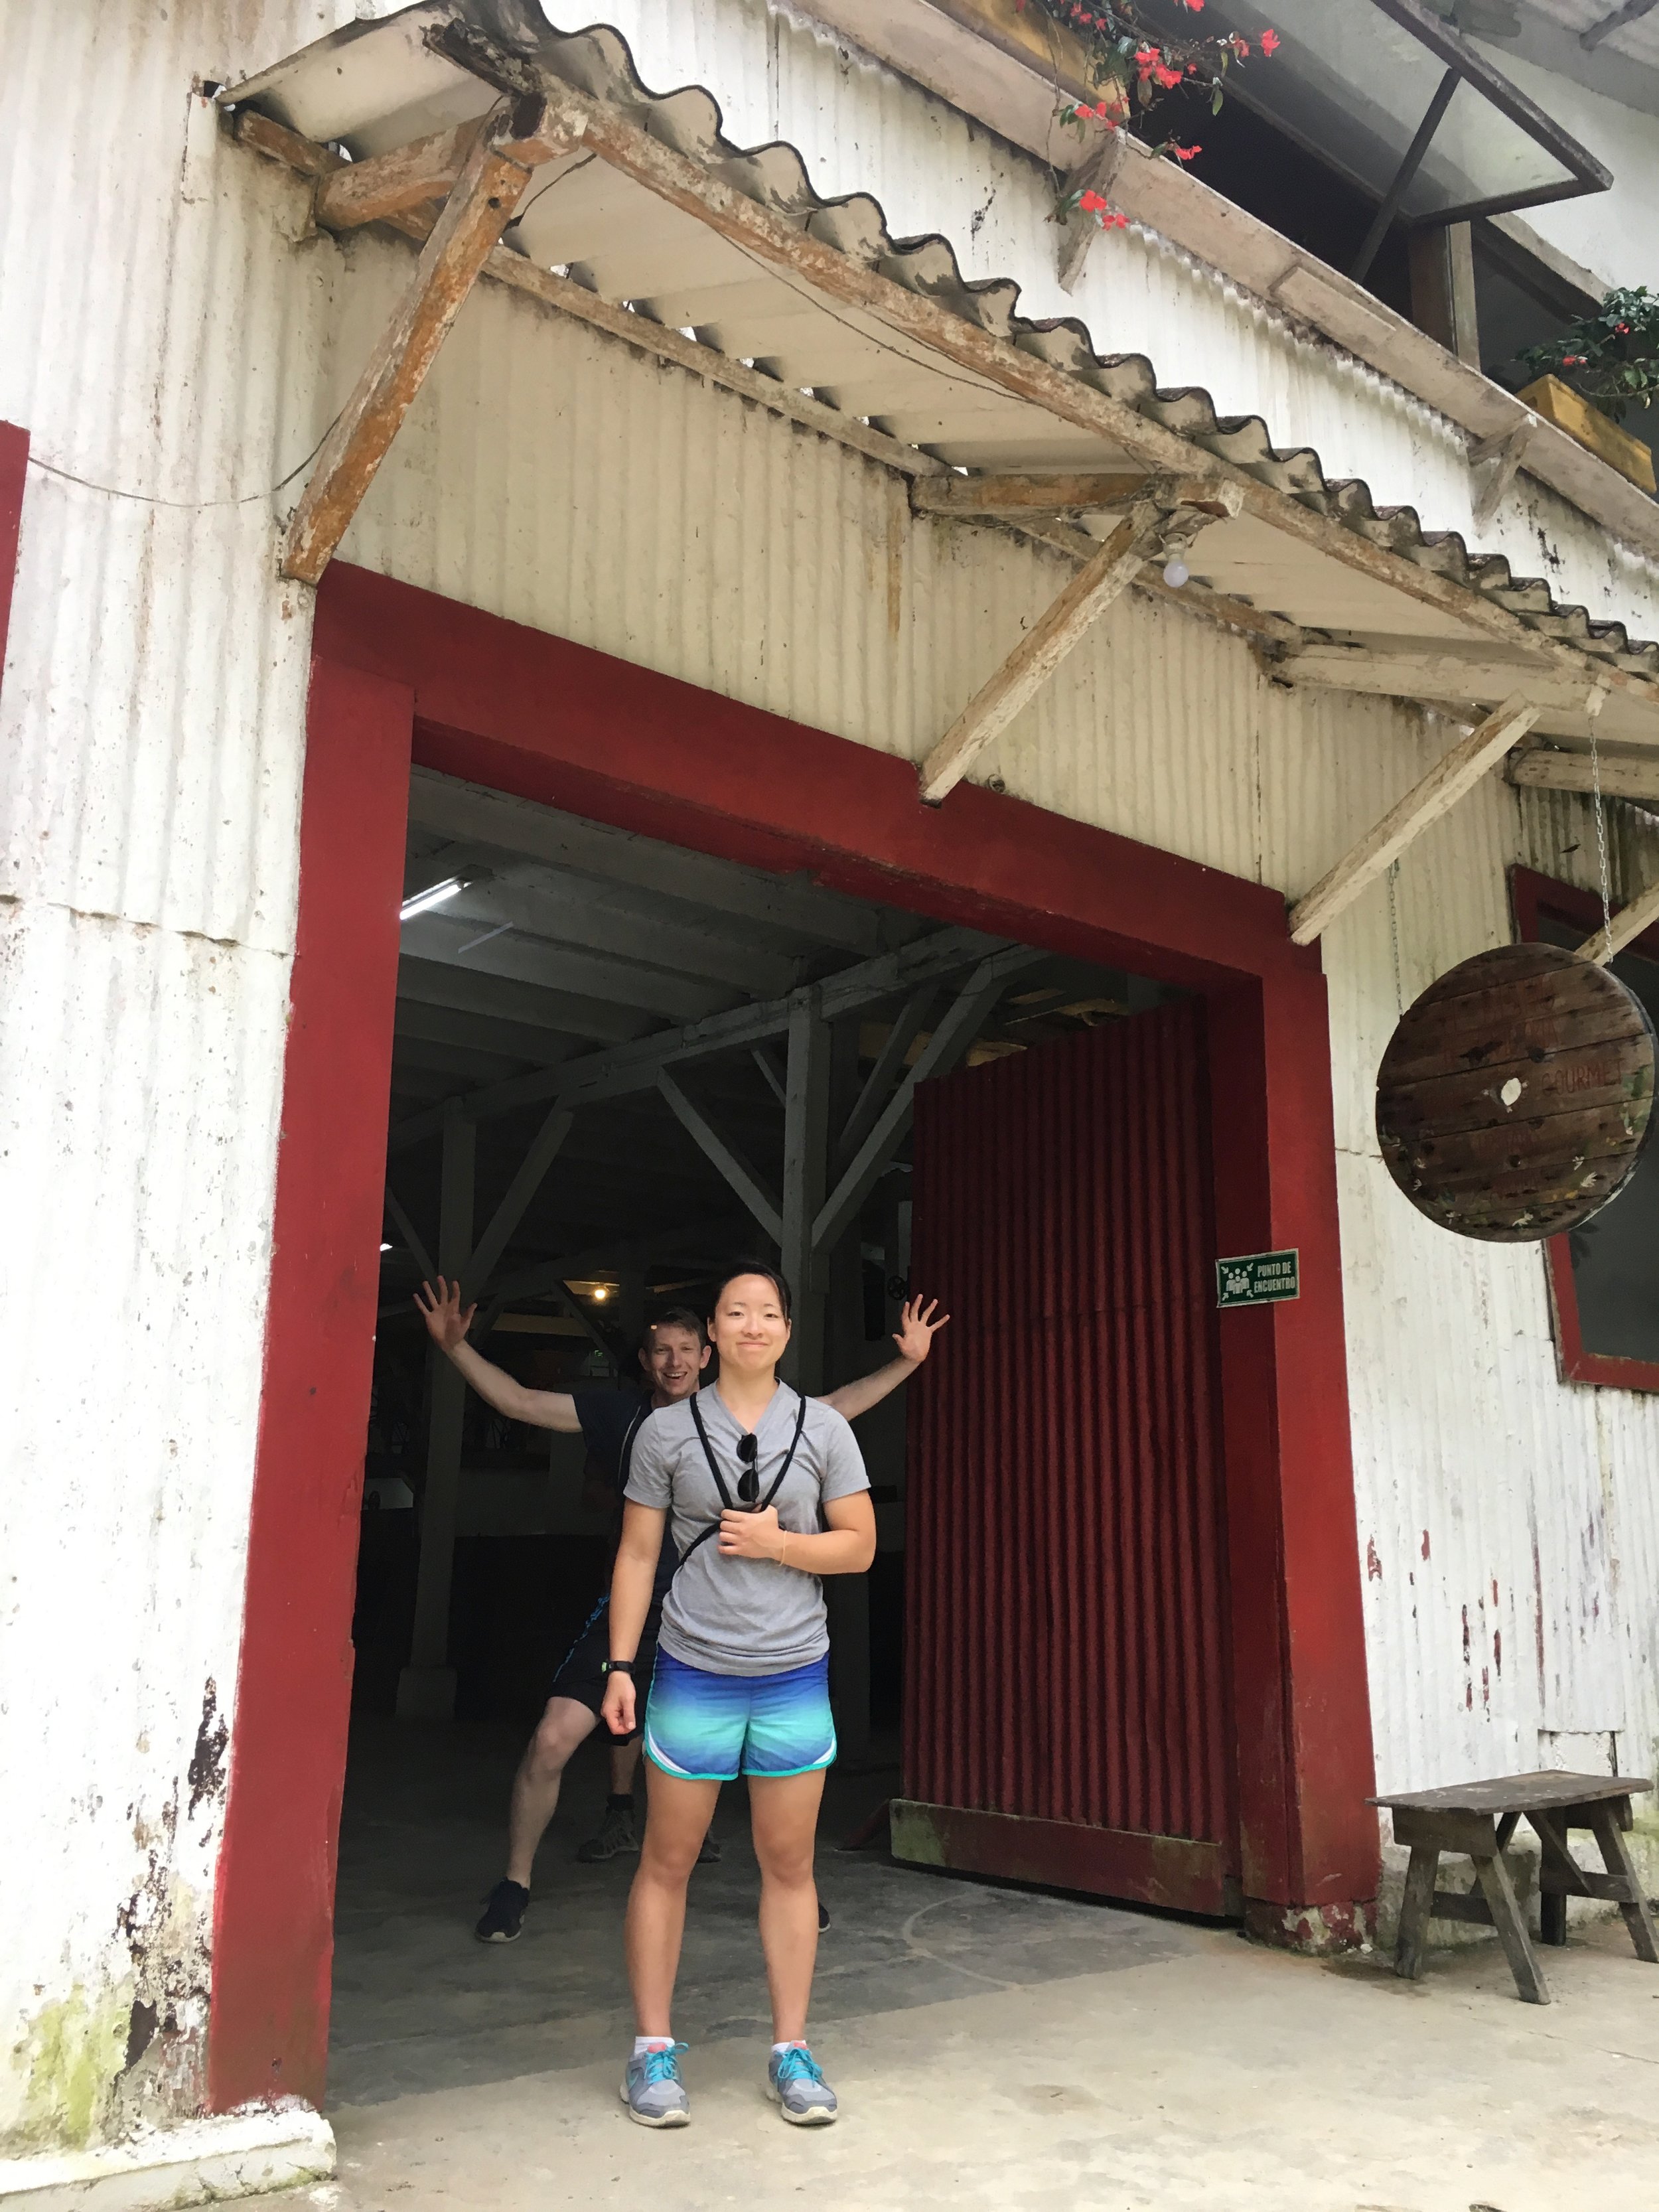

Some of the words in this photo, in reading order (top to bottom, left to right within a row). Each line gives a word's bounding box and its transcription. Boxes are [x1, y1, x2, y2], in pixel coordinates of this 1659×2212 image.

[1542, 1058, 1624, 1096] GOURMET
[1258, 1262, 1281, 1278] PUNTO
[1282, 1261, 1291, 1274] DE
[1254, 1276, 1295, 1293] ENCUENTRO
